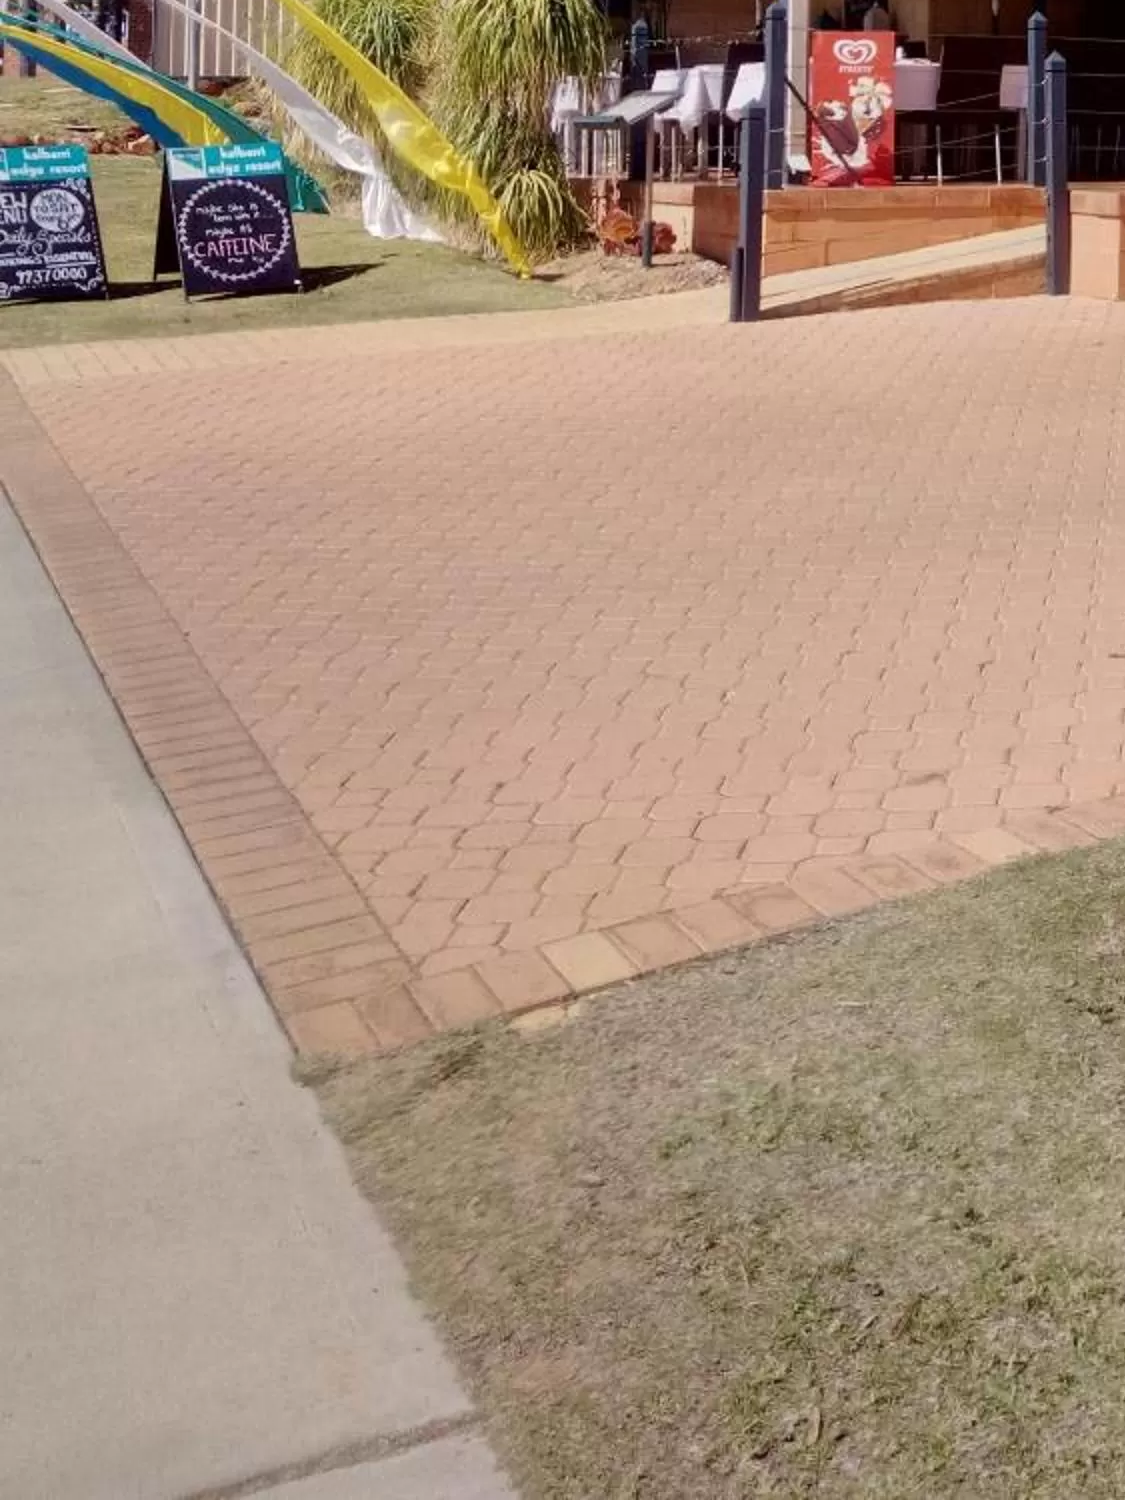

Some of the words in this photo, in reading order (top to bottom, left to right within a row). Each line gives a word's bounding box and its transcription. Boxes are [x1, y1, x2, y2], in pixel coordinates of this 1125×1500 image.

[22, 148, 71, 160] kalbarri
[219, 145, 266, 159] kalbarri
[10, 162, 45, 177] edge
[50, 163, 87, 174] resort
[207, 161, 239, 176] edge
[245, 160, 281, 171] resort
[0, 192, 27, 210] EW
[0, 209, 27, 225] ENU
[193, 233, 278, 258] CAFFEINE
